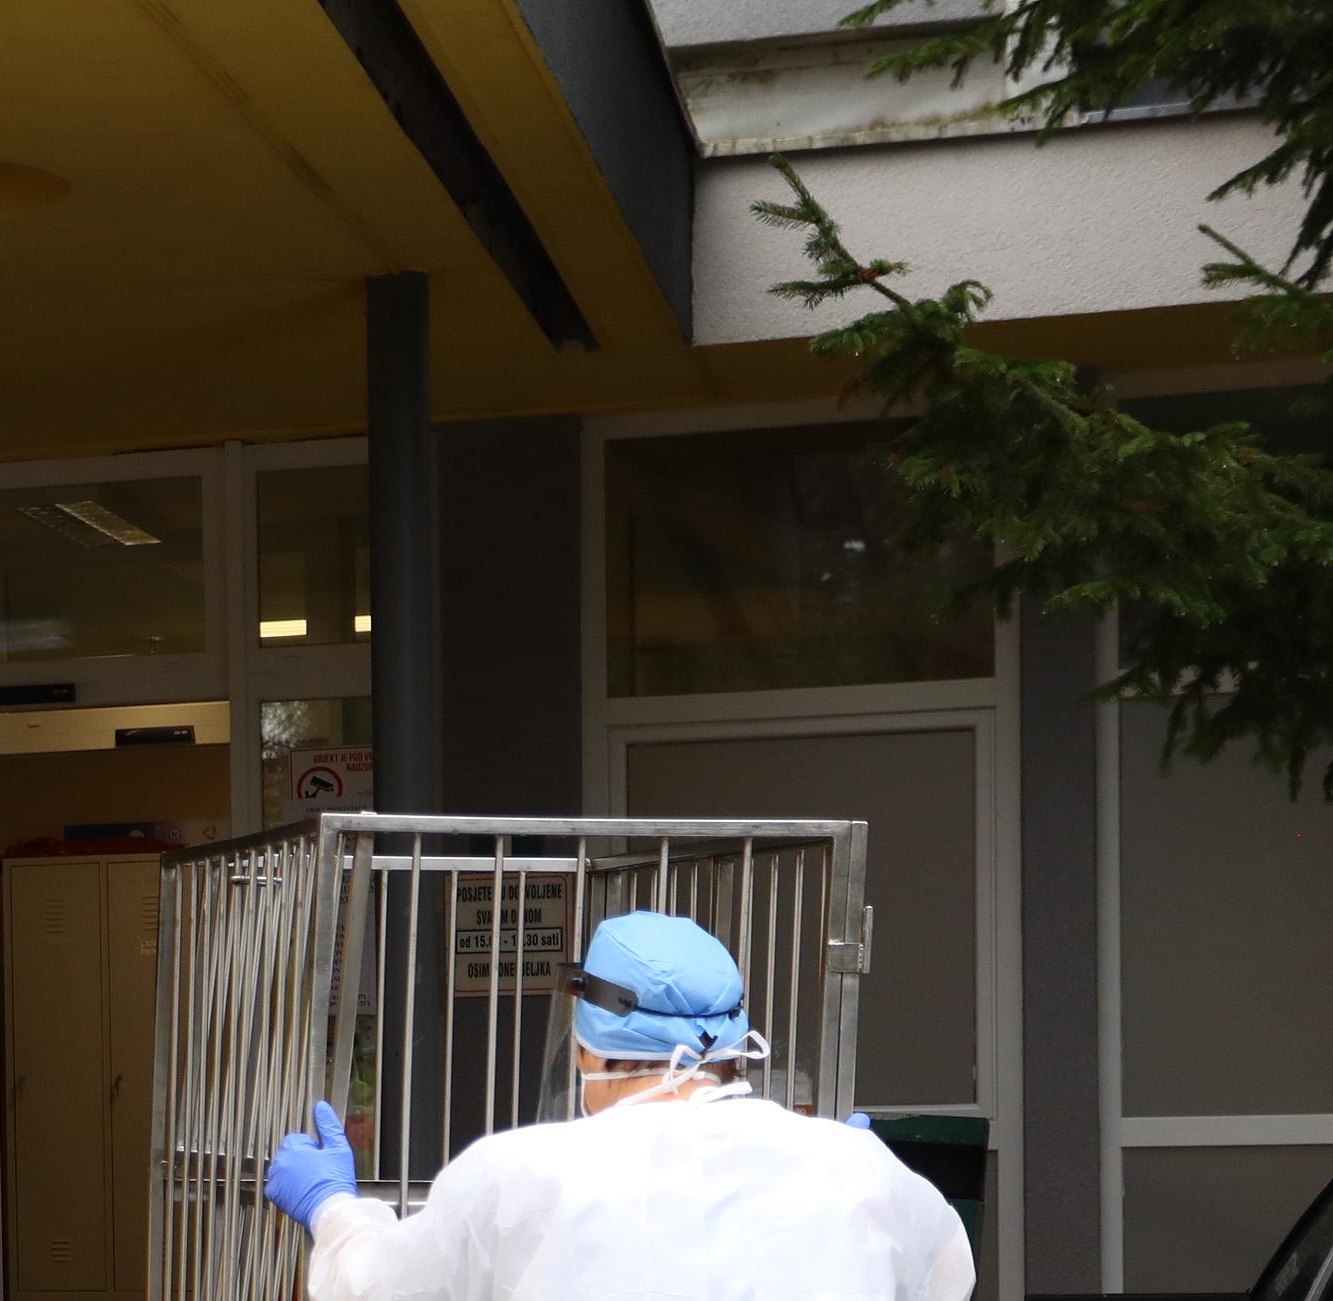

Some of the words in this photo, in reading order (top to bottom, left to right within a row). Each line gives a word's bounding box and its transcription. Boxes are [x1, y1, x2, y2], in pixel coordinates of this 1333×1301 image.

[457, 886, 492, 902] POSJETE
[509, 884, 563, 900] DOVOLJENE
[459, 935, 471, 948] od
[511, 933, 538, 947] 1.30
[541, 932, 559, 946] sati
[468, 962, 489, 978] OSIM
